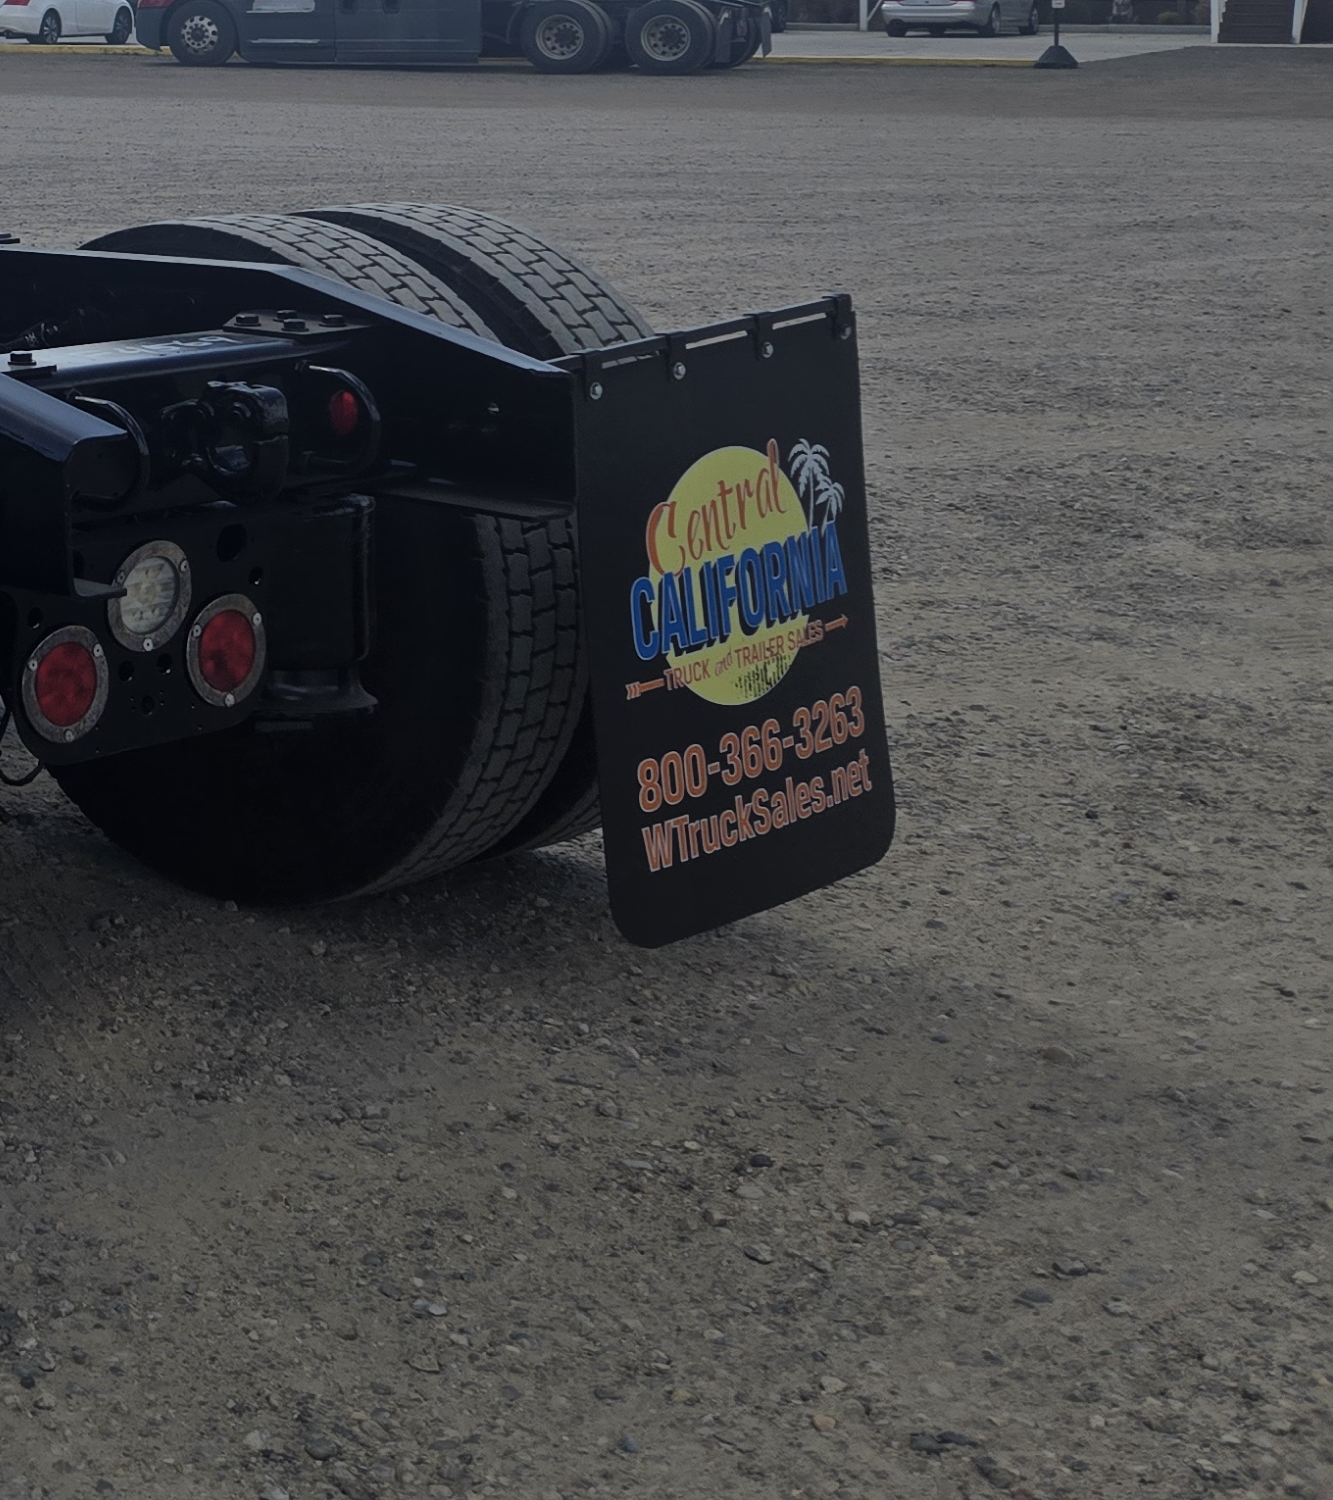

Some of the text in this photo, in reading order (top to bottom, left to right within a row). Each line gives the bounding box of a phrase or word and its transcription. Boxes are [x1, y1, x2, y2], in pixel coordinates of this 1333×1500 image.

[645, 438, 786, 579] Central
[630, 523, 849, 662] CALIFORNIA
[663, 619, 824, 690] TRUCK and TRAILER SALES
[637, 686, 866, 814] 800-366-3263
[641, 749, 873, 873] WTruckSales.net
